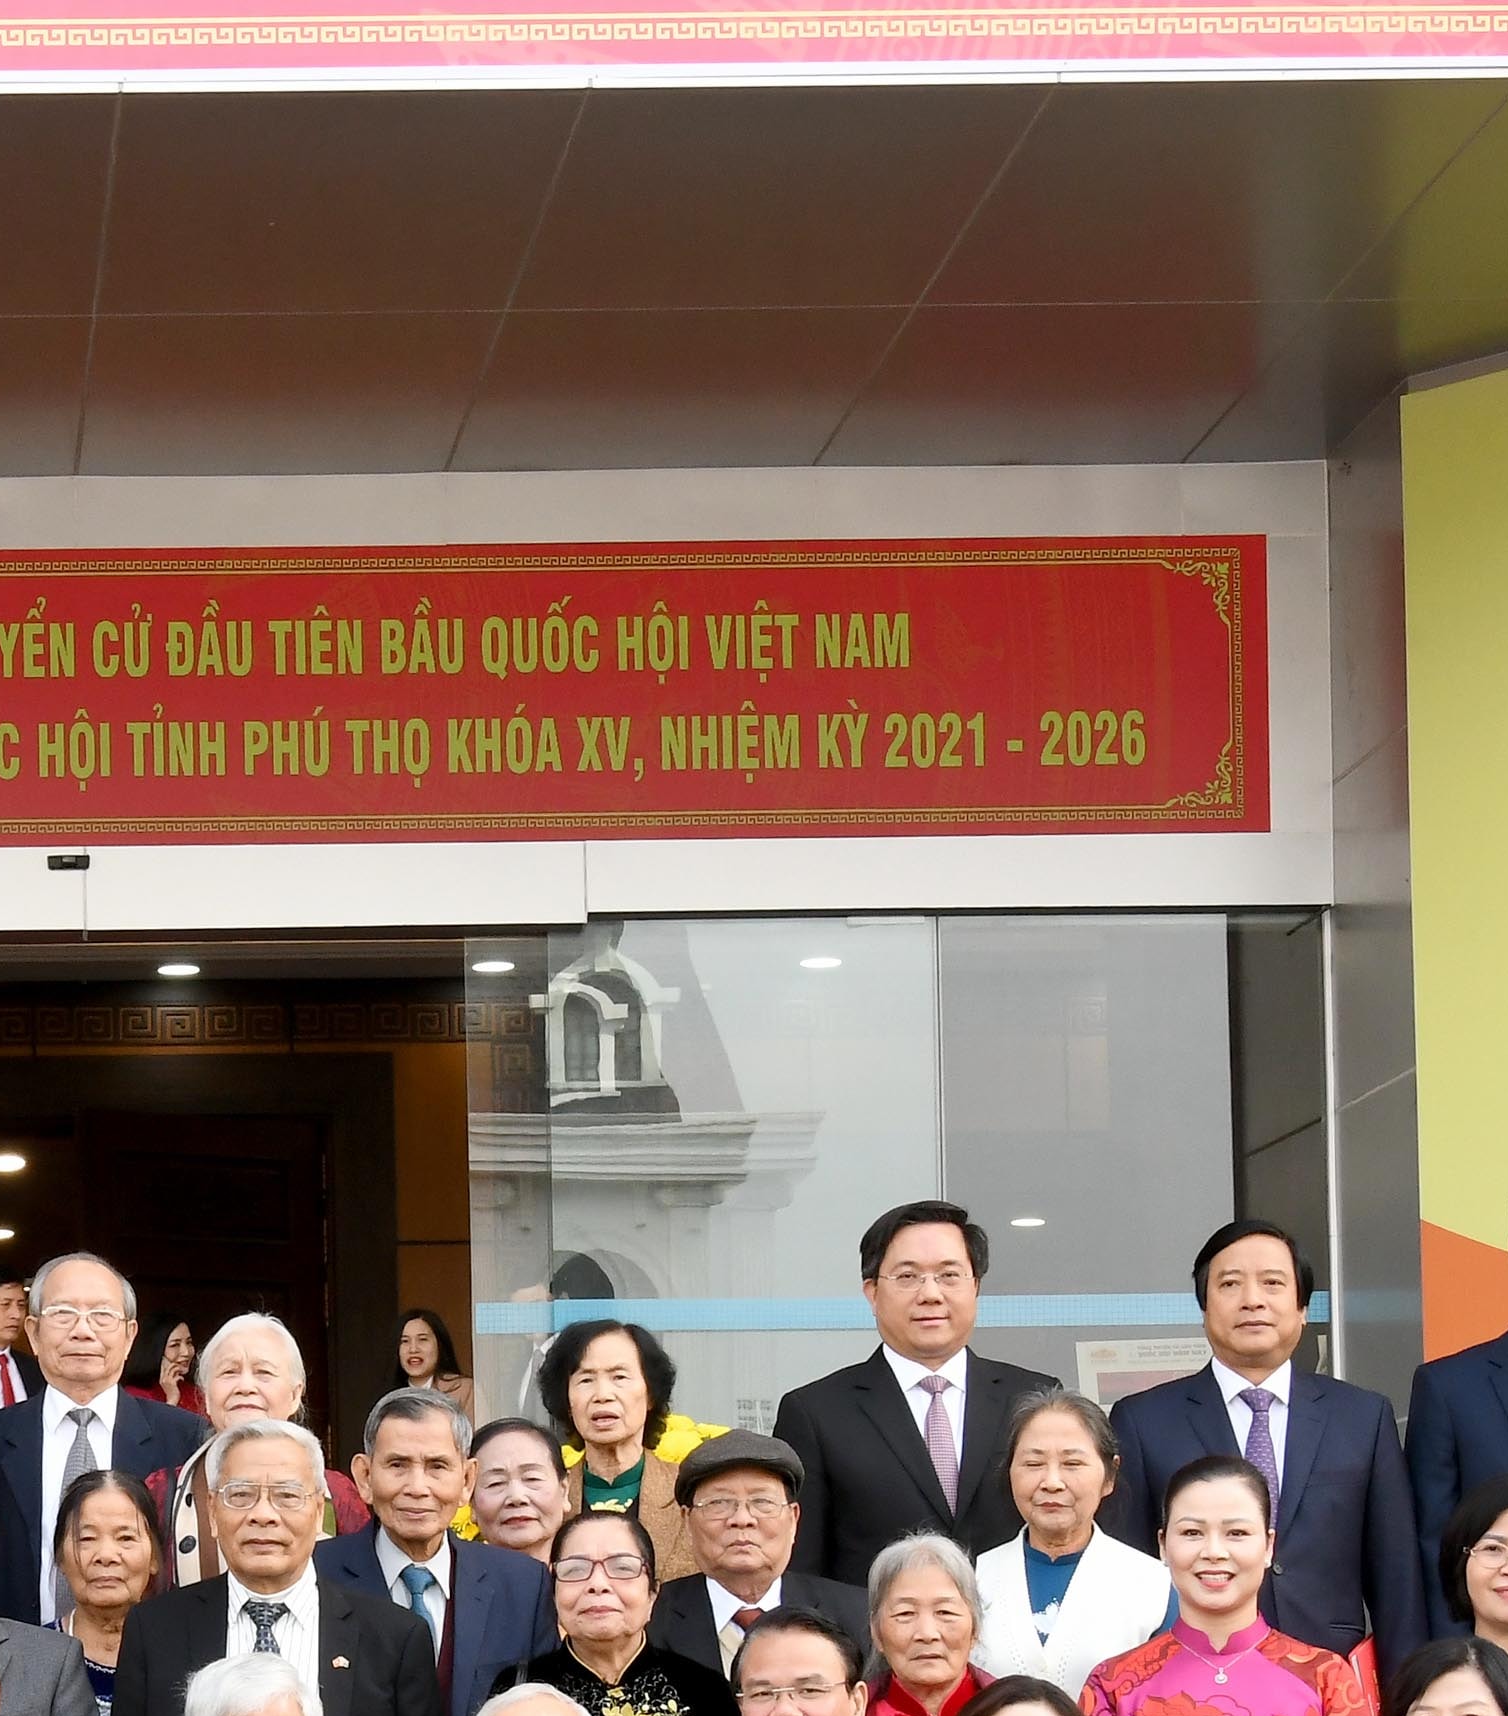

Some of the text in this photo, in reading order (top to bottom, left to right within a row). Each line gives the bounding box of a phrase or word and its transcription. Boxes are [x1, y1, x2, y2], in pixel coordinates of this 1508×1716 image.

[92, 602, 153, 678] CỬ
[165, 599, 253, 677] ĐẦU
[268, 604, 363, 676] TIÊN
[380, 597, 464, 675] BẦU
[481, 595, 600, 680] QUỐC
[616, 600, 689, 684] HỘI
[705, 599, 800, 683] VIỆT
[815, 612, 910, 669] NAM
[38, 708, 111, 791] HỘI
[126, 703, 226, 777] TỈNH
[243, 707, 330, 777] PHÚ
[344, 717, 431, 788] THỌ
[447, 703, 563, 775] KHÓA
[576, 716, 644, 780] XV,
[660, 700, 801, 784] NHIỆM
[818, 698, 869, 769] KỲ
[884, 711, 985, 769] 2021
[1007, 739, 1024, 752] -
[1039, 709, 1146, 767] 2026
